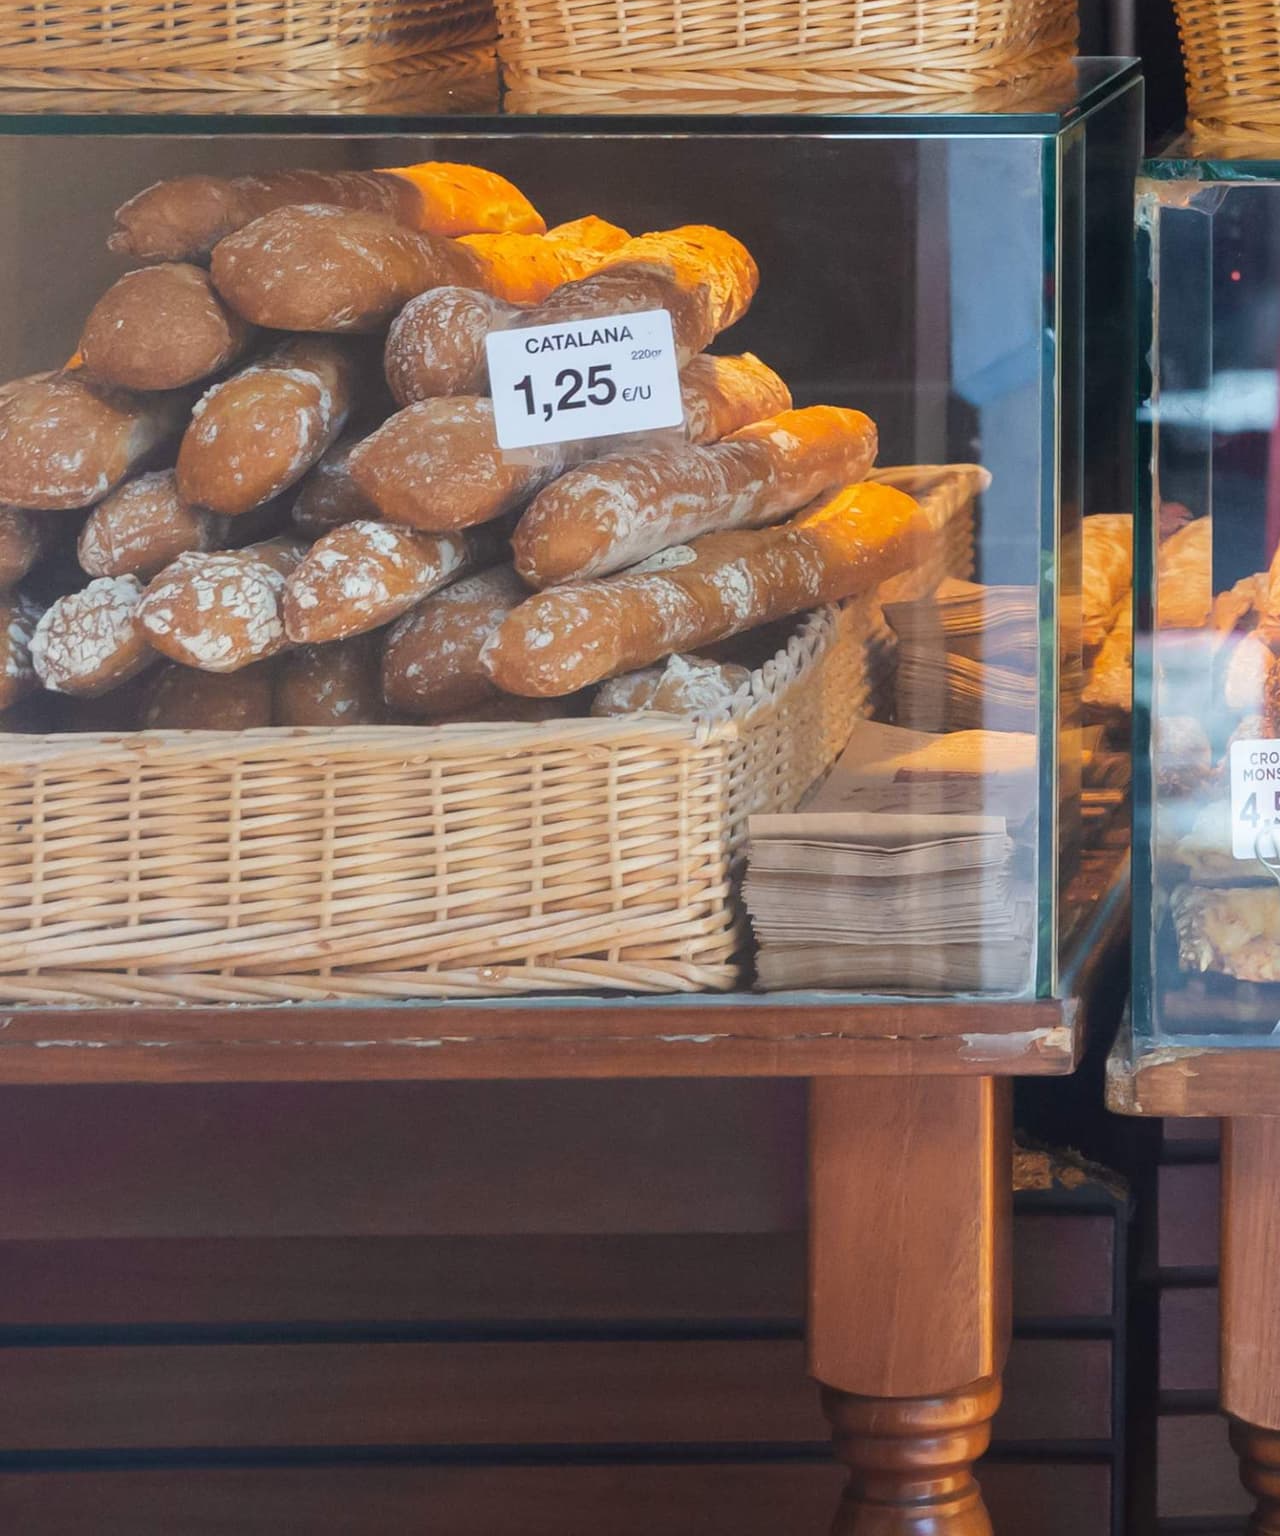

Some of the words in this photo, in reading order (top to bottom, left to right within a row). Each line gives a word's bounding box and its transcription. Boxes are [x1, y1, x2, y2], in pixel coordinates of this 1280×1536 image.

[525, 325, 633, 354] CATALANA
[513, 364, 616, 422] 1,25
[622, 385, 651, 401] €/U
